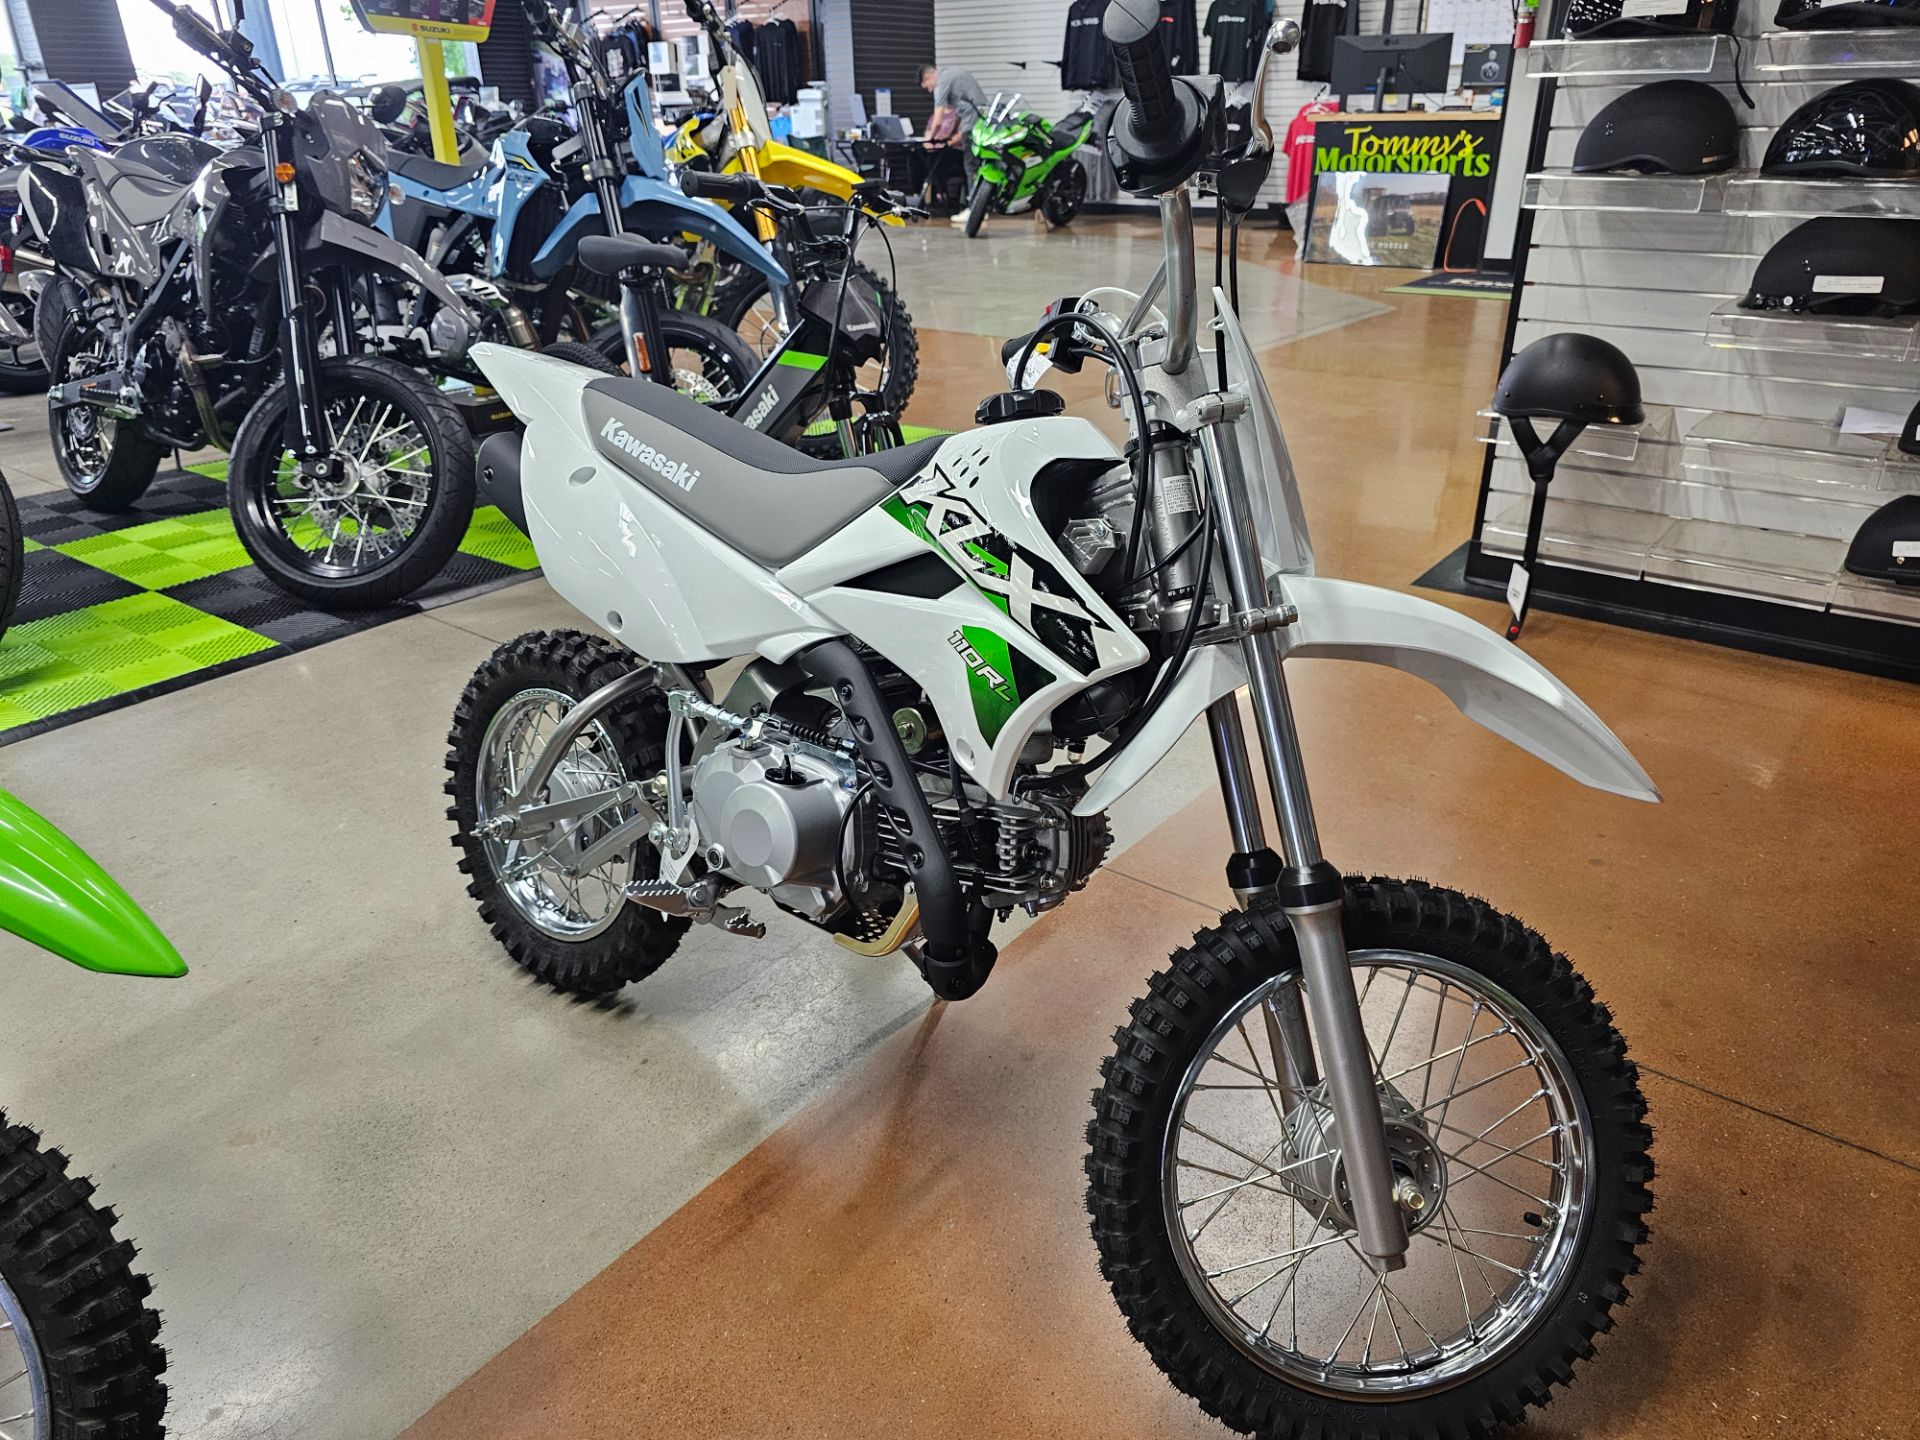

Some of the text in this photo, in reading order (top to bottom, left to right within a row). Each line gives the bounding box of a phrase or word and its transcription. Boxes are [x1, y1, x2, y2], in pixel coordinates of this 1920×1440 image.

[420, 24, 451, 34] SUZUKI
[58, 132, 96, 147] SUZUKI
[1344, 125, 1484, 163] Tommy's
[1314, 147, 1490, 178] Motorsports
[743, 384, 780, 430] asaki
[600, 417, 701, 492] Kawasaki
[898, 465, 1100, 641] KLX
[946, 629, 1012, 702] 110RL
